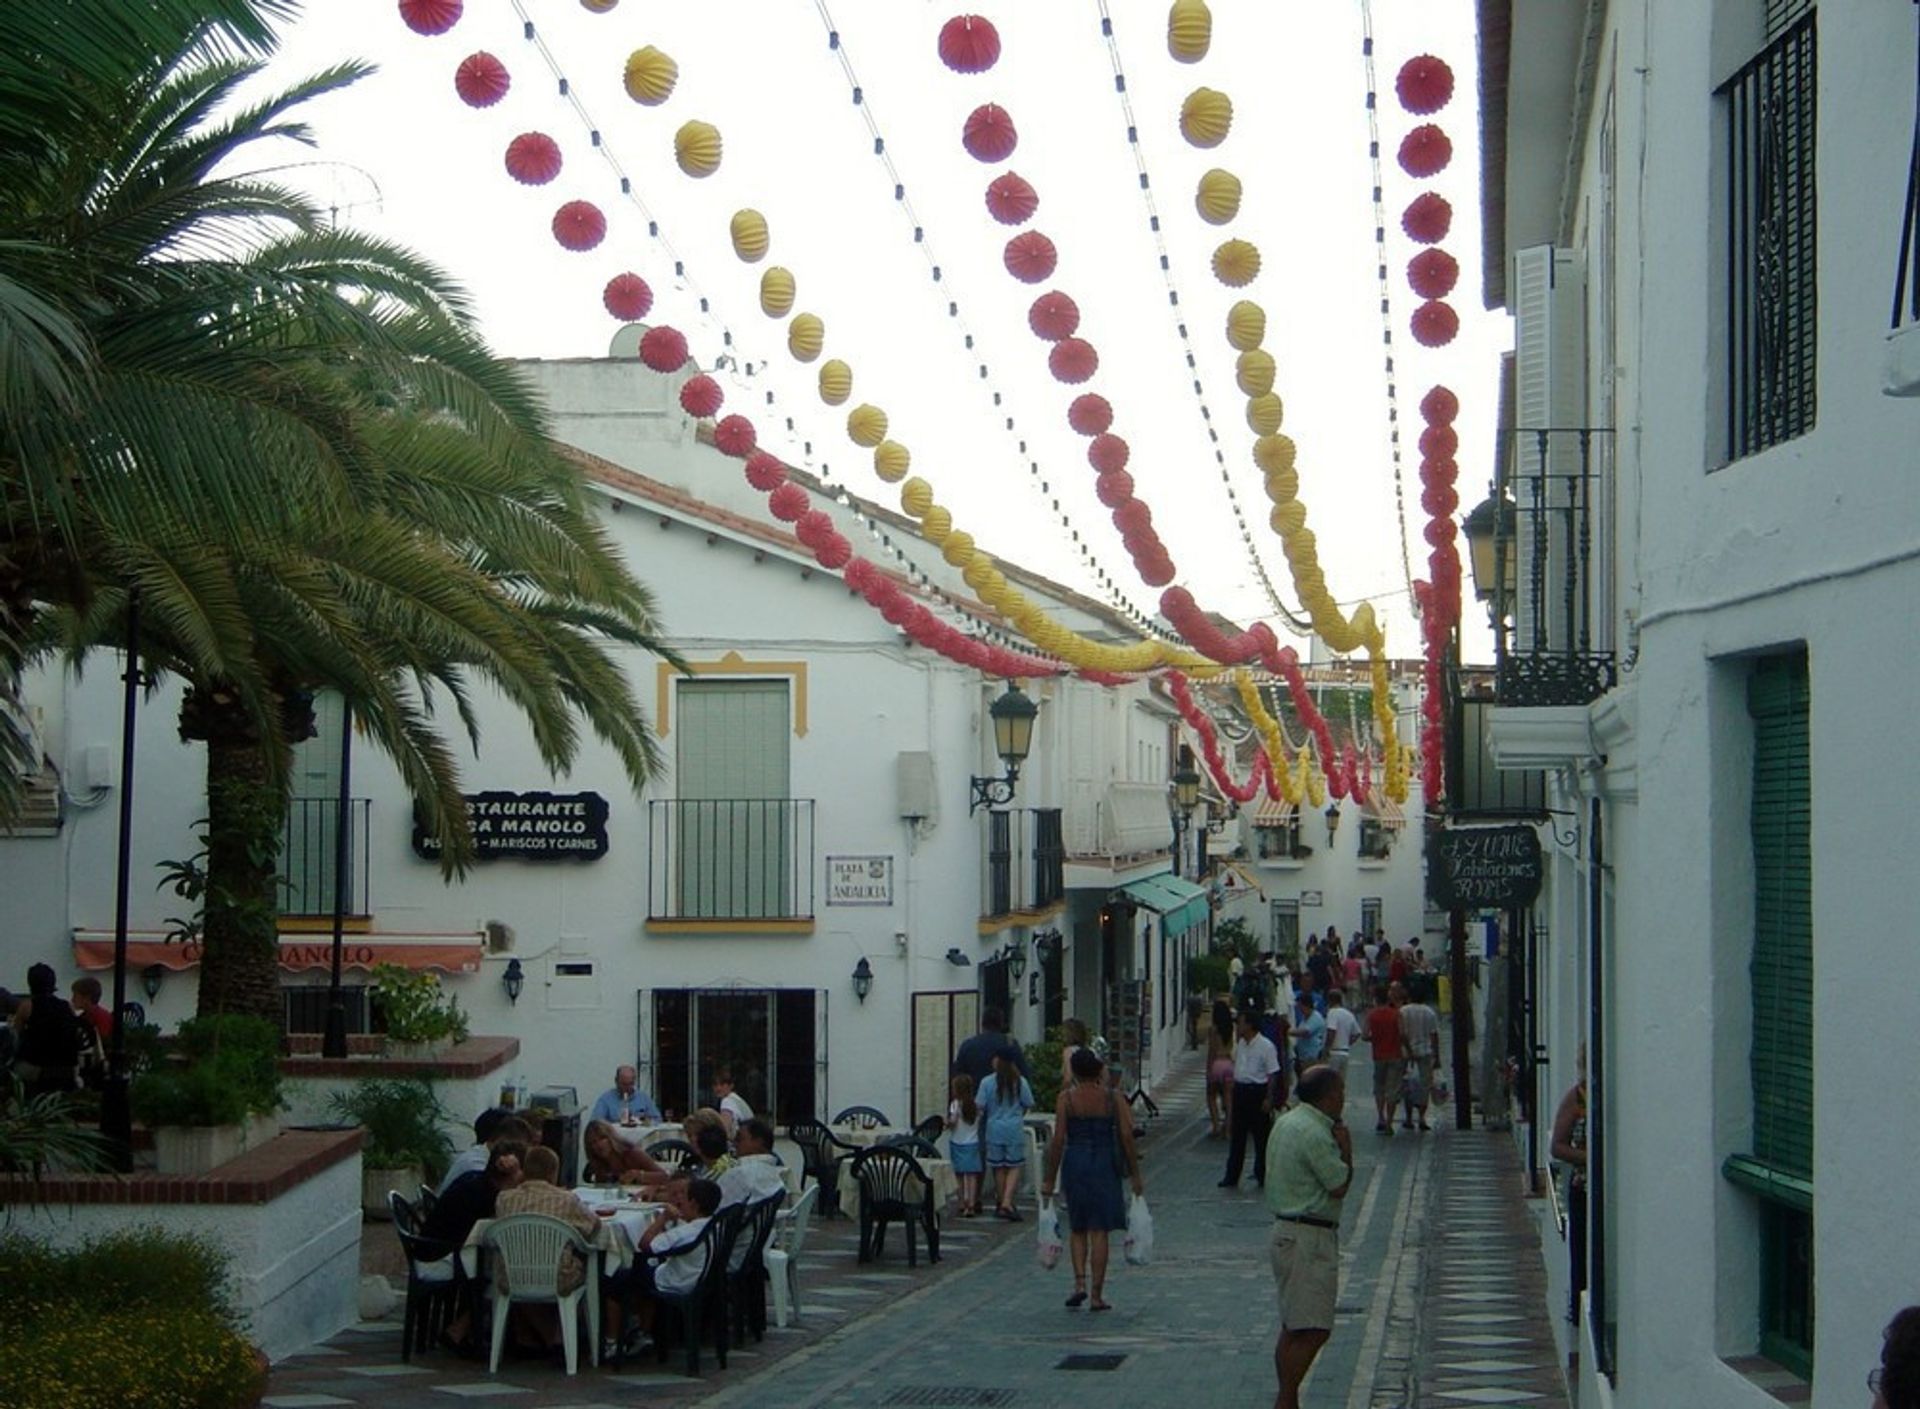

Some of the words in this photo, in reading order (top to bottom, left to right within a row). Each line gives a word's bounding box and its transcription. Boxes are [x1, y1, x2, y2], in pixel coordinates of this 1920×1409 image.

[465, 802, 587, 817] STAURANTE
[501, 819, 587, 834] MANOLO
[489, 837, 547, 850] MARISCOS
[549, 838, 557, 849] Y
[556, 838, 598, 851] CARNES
[278, 946, 374, 963] ANOLO
